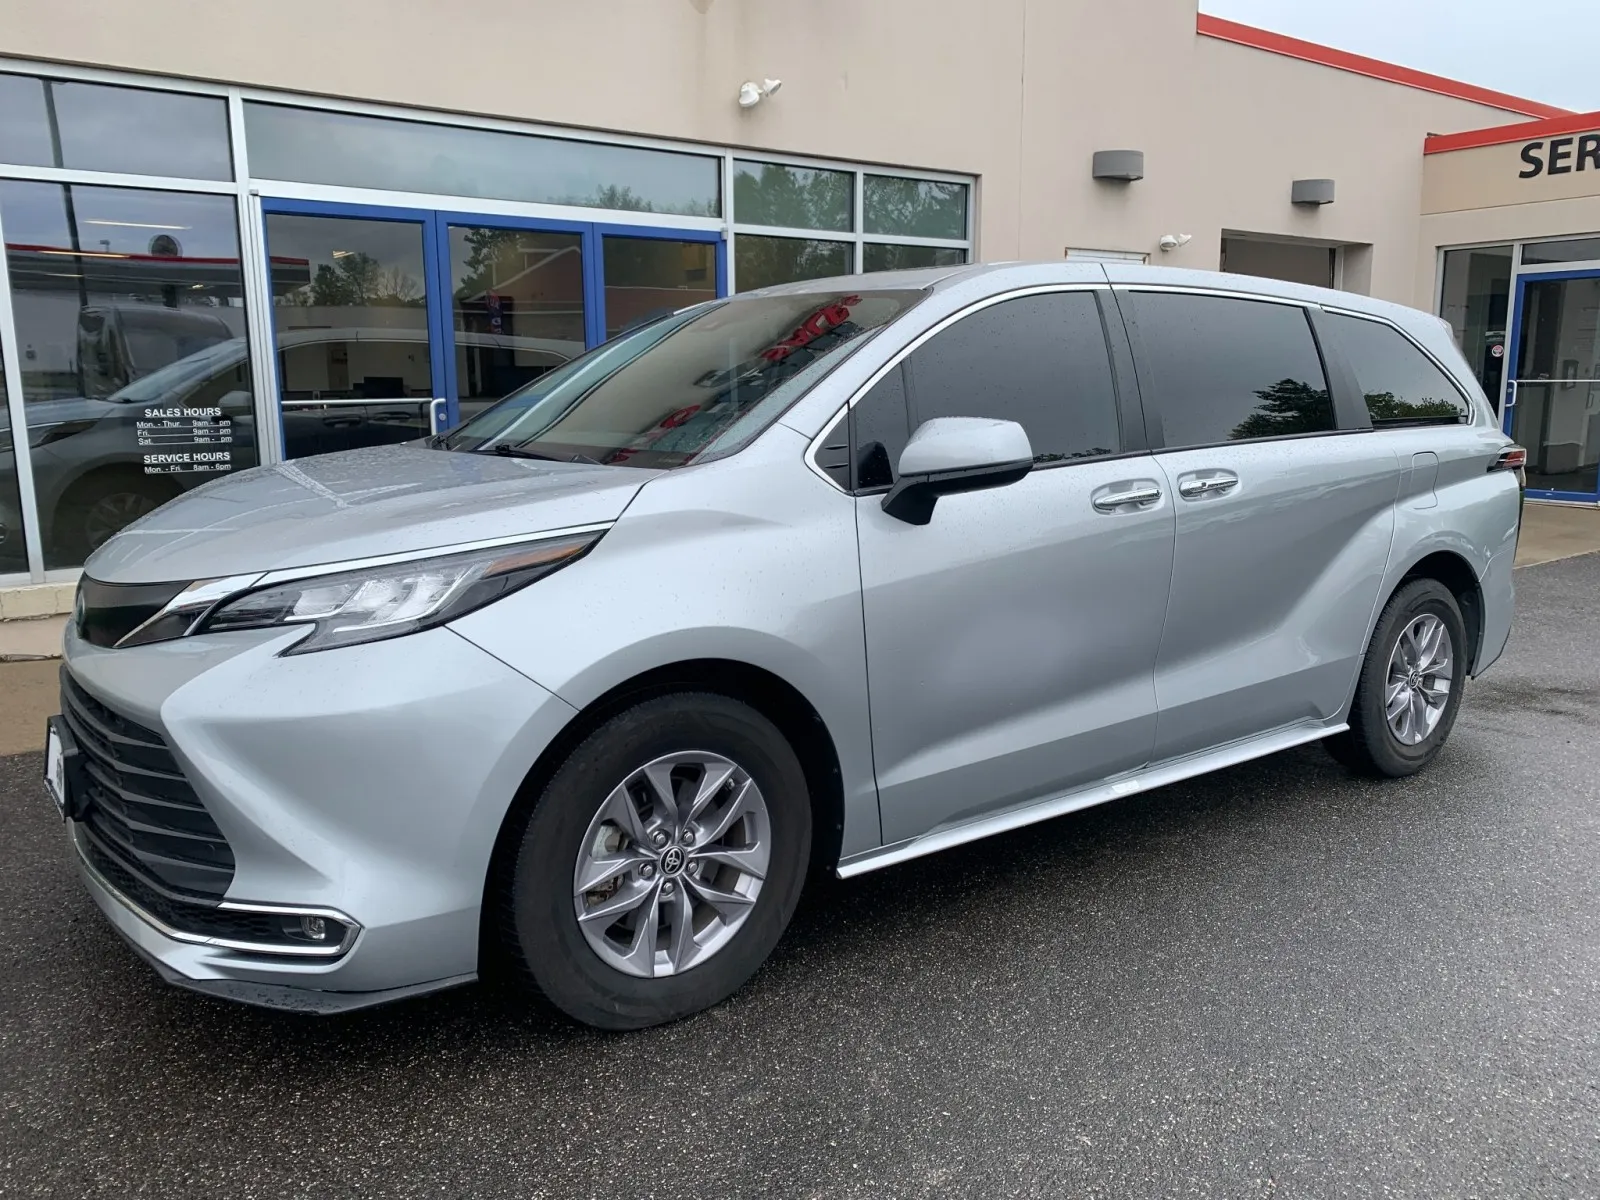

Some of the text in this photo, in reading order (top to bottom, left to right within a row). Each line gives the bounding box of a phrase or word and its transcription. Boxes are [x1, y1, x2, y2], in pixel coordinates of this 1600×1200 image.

[1519, 134, 1600, 178] SER
[145, 407, 221, 417] SALES HOURS
[137, 429, 150, 437] Fri.
[143, 452, 230, 463] SERVICE HOURS
[144, 466, 164, 474] Mon.
[215, 463, 231, 471] 6pm
